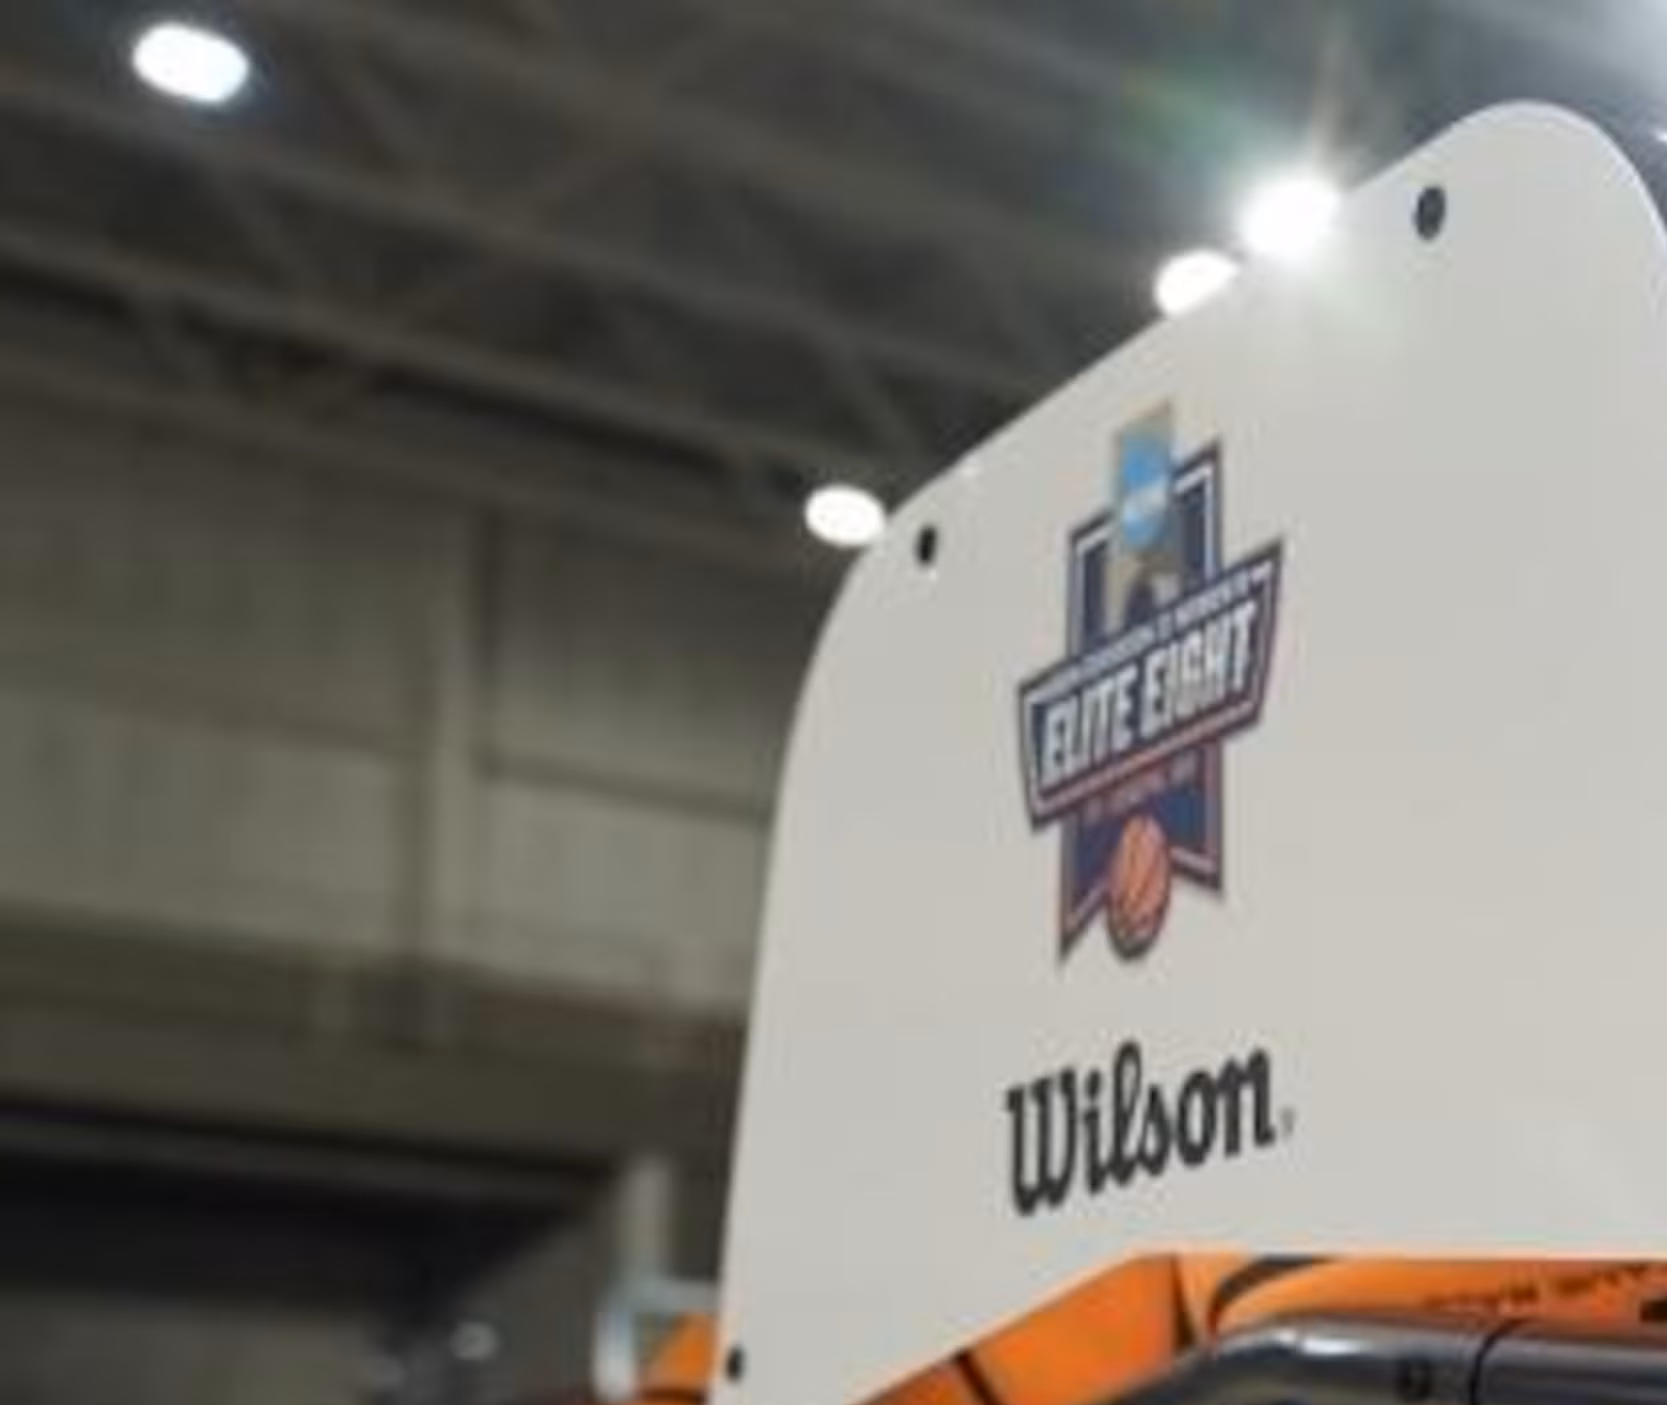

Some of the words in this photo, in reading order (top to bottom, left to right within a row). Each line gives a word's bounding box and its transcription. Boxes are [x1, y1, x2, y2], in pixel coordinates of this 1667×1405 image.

[1041, 665, 1140, 788] ELITE
[1141, 602, 1258, 741] EIGHT
[1005, 1040, 1277, 1218] Wilson
